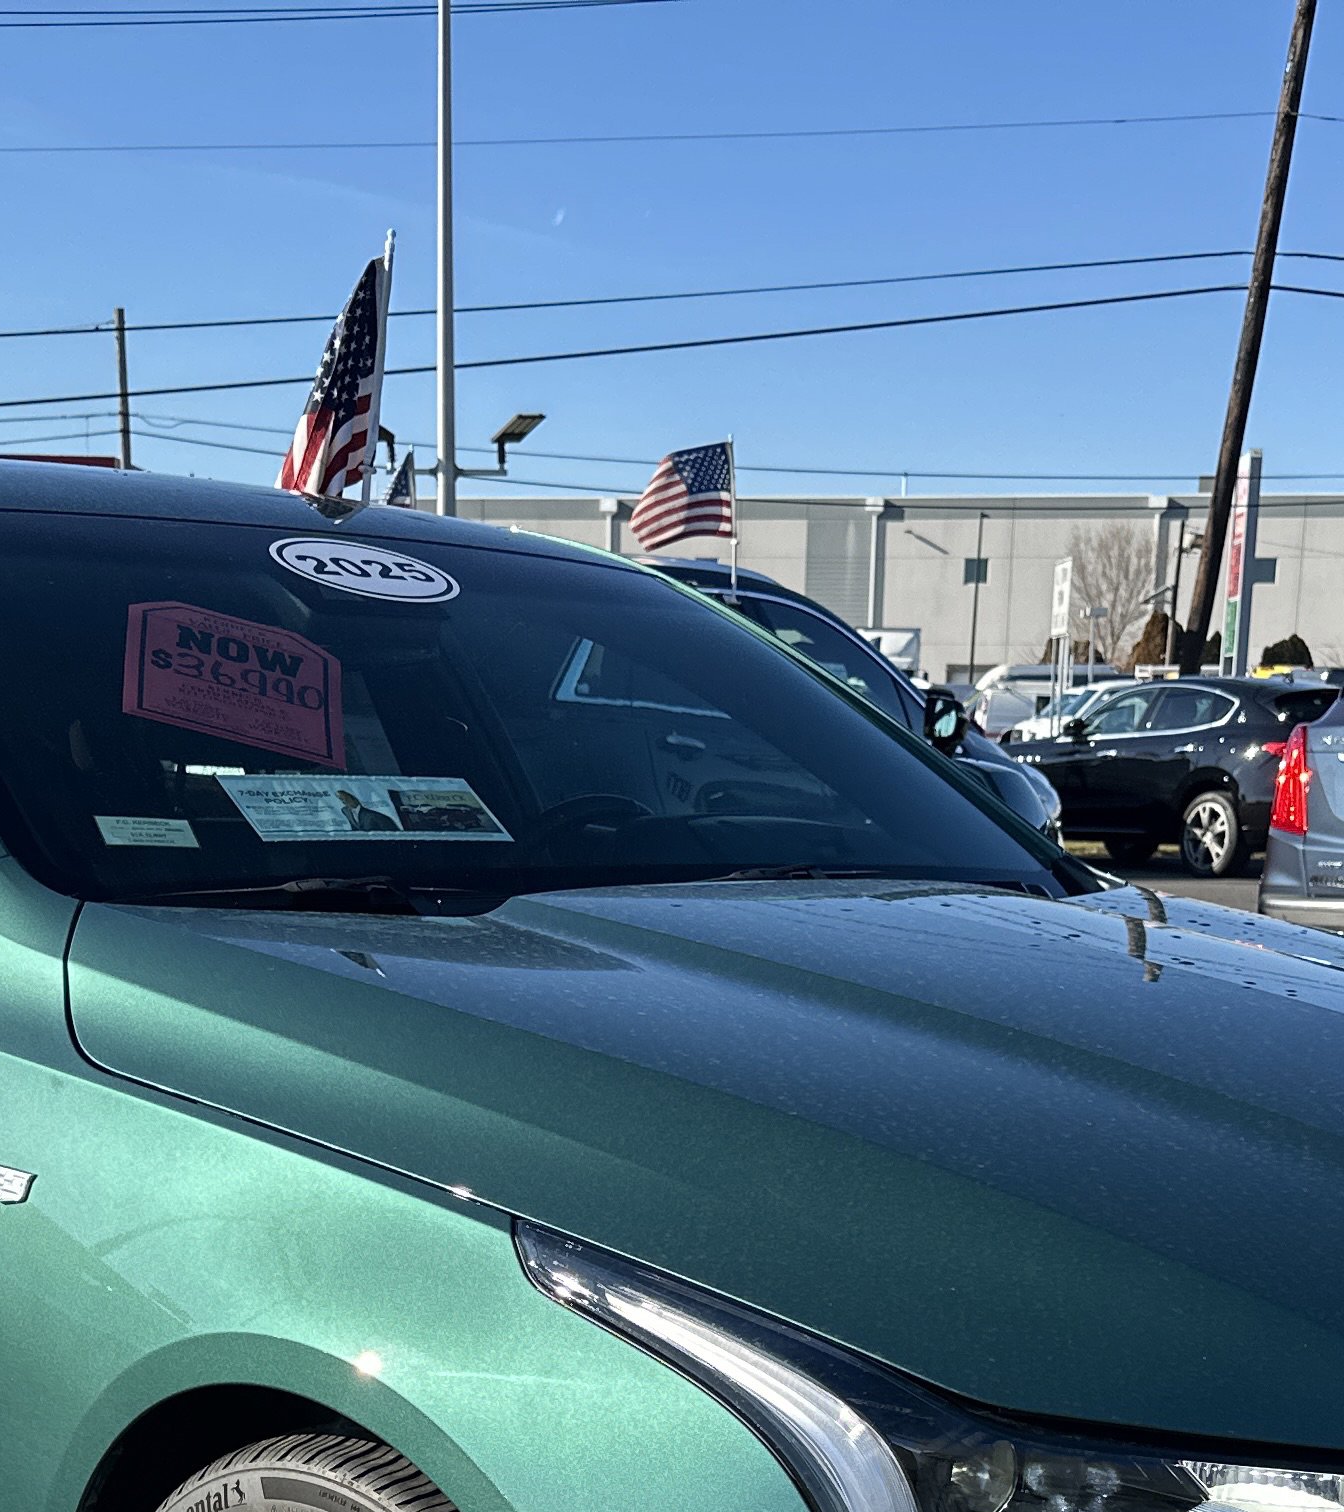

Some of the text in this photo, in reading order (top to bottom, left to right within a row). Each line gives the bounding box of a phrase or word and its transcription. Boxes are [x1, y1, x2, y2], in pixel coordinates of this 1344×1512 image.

[294, 554, 436, 583] 2025
[176, 624, 305, 679] NOW
[271, 790, 331, 798] EXCHANGE
